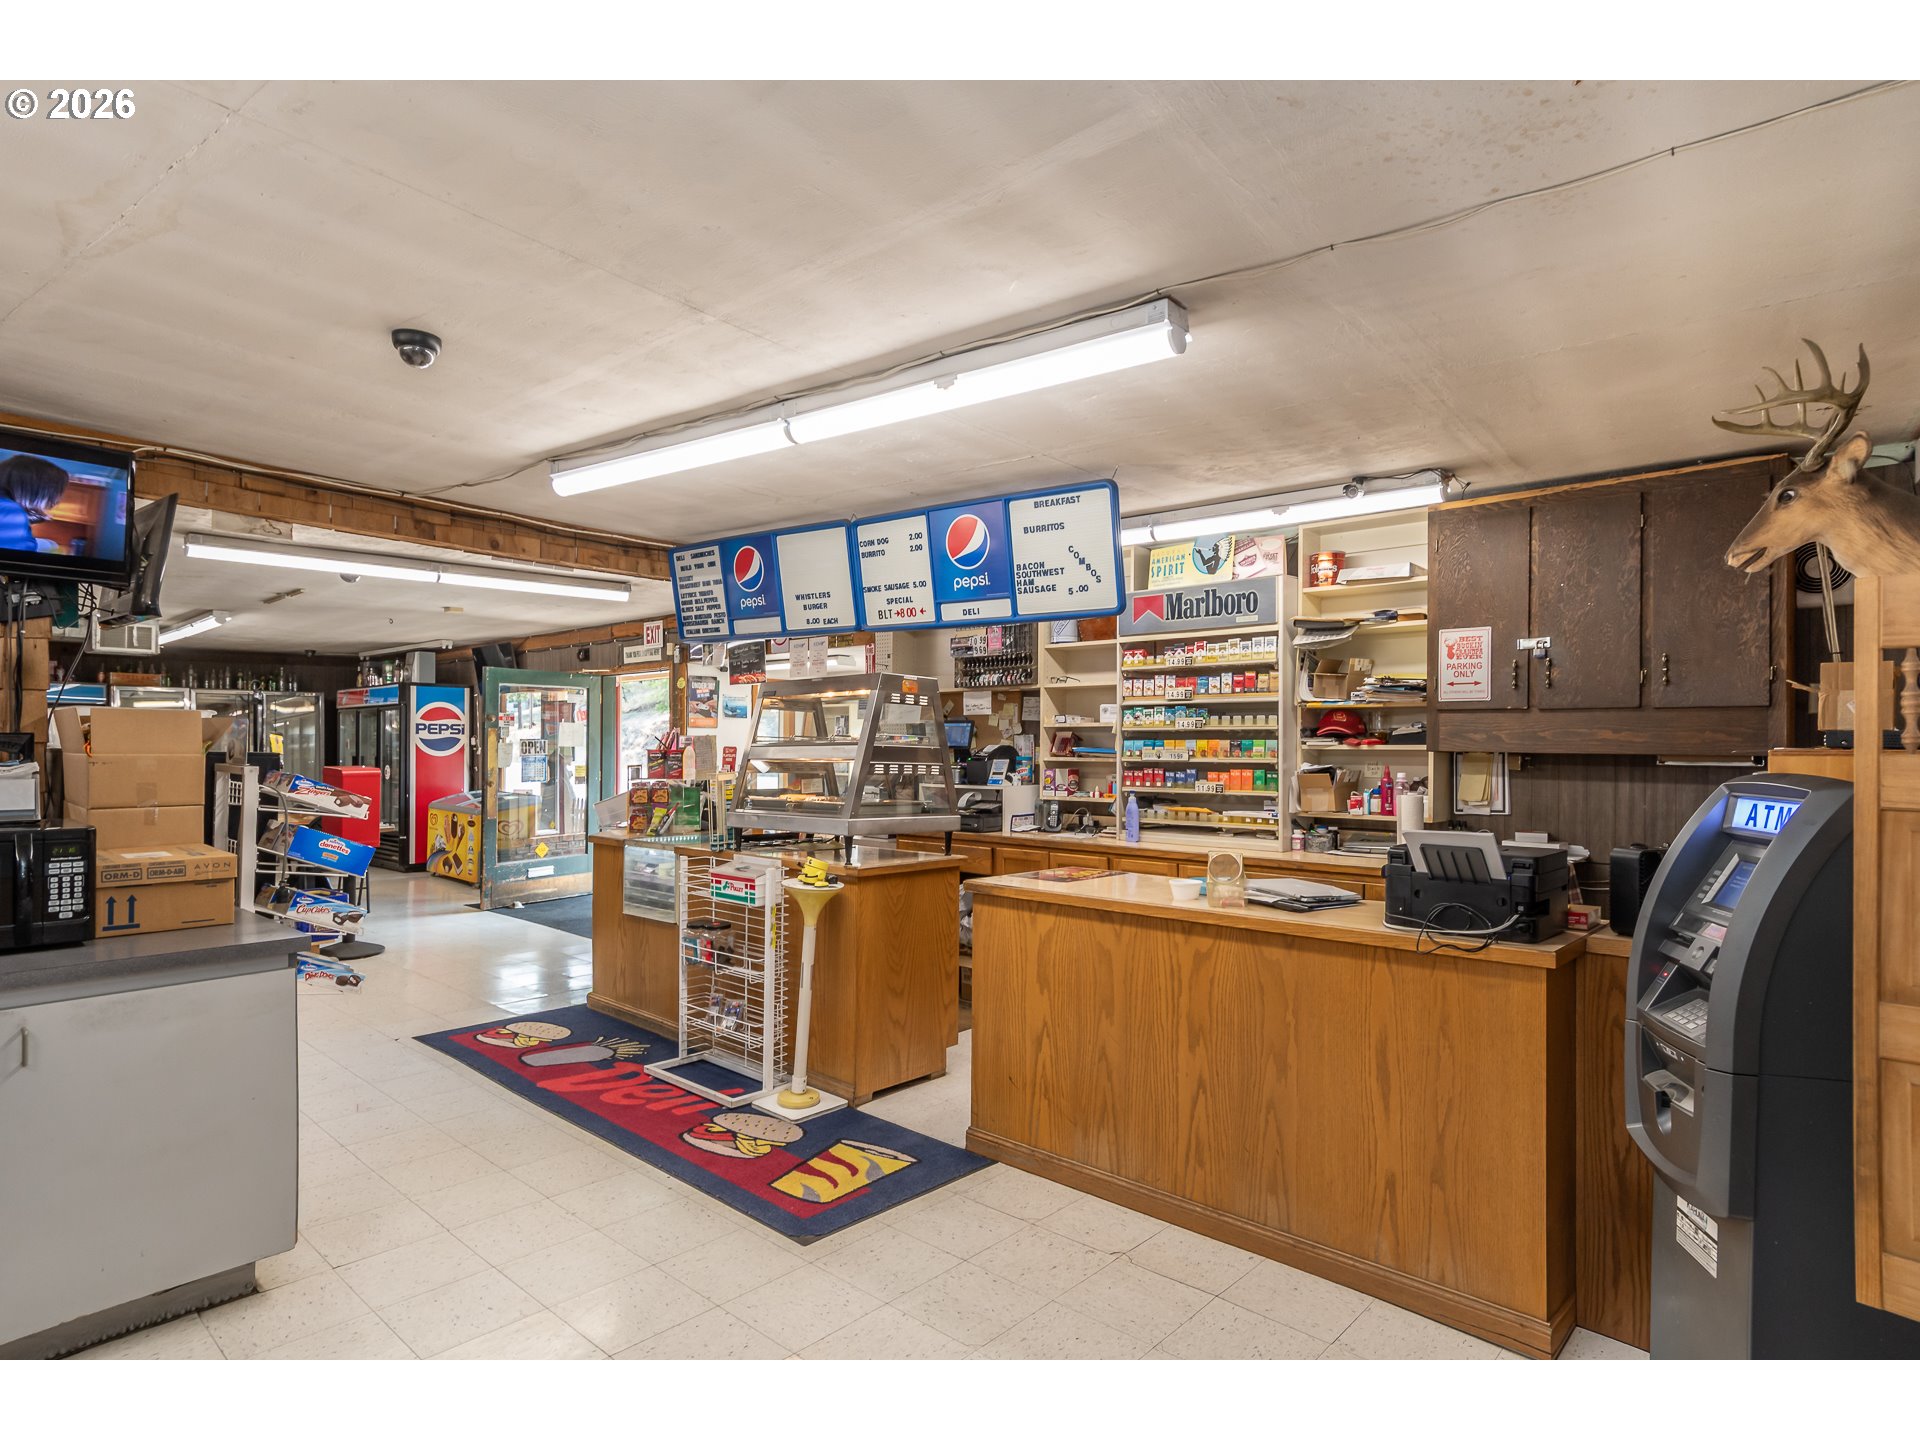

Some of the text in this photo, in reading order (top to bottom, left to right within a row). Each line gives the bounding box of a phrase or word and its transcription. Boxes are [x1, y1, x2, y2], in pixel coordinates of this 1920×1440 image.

[1034, 495, 1081, 508] BREAKFAST
[1023, 522, 1065, 534] BURRITOS
[859, 532, 923, 548] CORN DOG 2.00
[861, 544, 923, 559] BURRITO 2.00
[1152, 554, 1185, 564] AMERICAN
[1016, 561, 1045, 571] BACON
[1152, 562, 1184, 578] SPIRIT
[1015, 567, 1065, 579] SOUTHWEST
[863, 580, 927, 594] SMOKE SAUSAGE 5.00
[953, 572, 991, 591] pepsi
[1016, 578, 1035, 587] HAM
[1017, 584, 1057, 594] SAUSAGE
[740, 594, 767, 610] pepsi
[795, 592, 831, 601] WHISTLERS
[886, 596, 914, 604] SPECIAL
[803, 602, 828, 611] BURGER
[1165, 588, 1259, 620] Marlboro
[877, 609, 893, 620] BLT
[962, 608, 980, 616] DELI
[823, 617, 838, 625] EACH
[646, 624, 660, 644] EXIT
[1446, 662, 1482, 670] PARKING
[1454, 670, 1475, 678] ONLY
[521, 740, 546, 754] OPEN
[294, 787, 332, 796] Zingers
[1744, 803, 1792, 831] ATM
[320, 842, 349, 854] donettes
[104, 872, 140, 880] ORM-D
[194, 862, 231, 870] AVON
